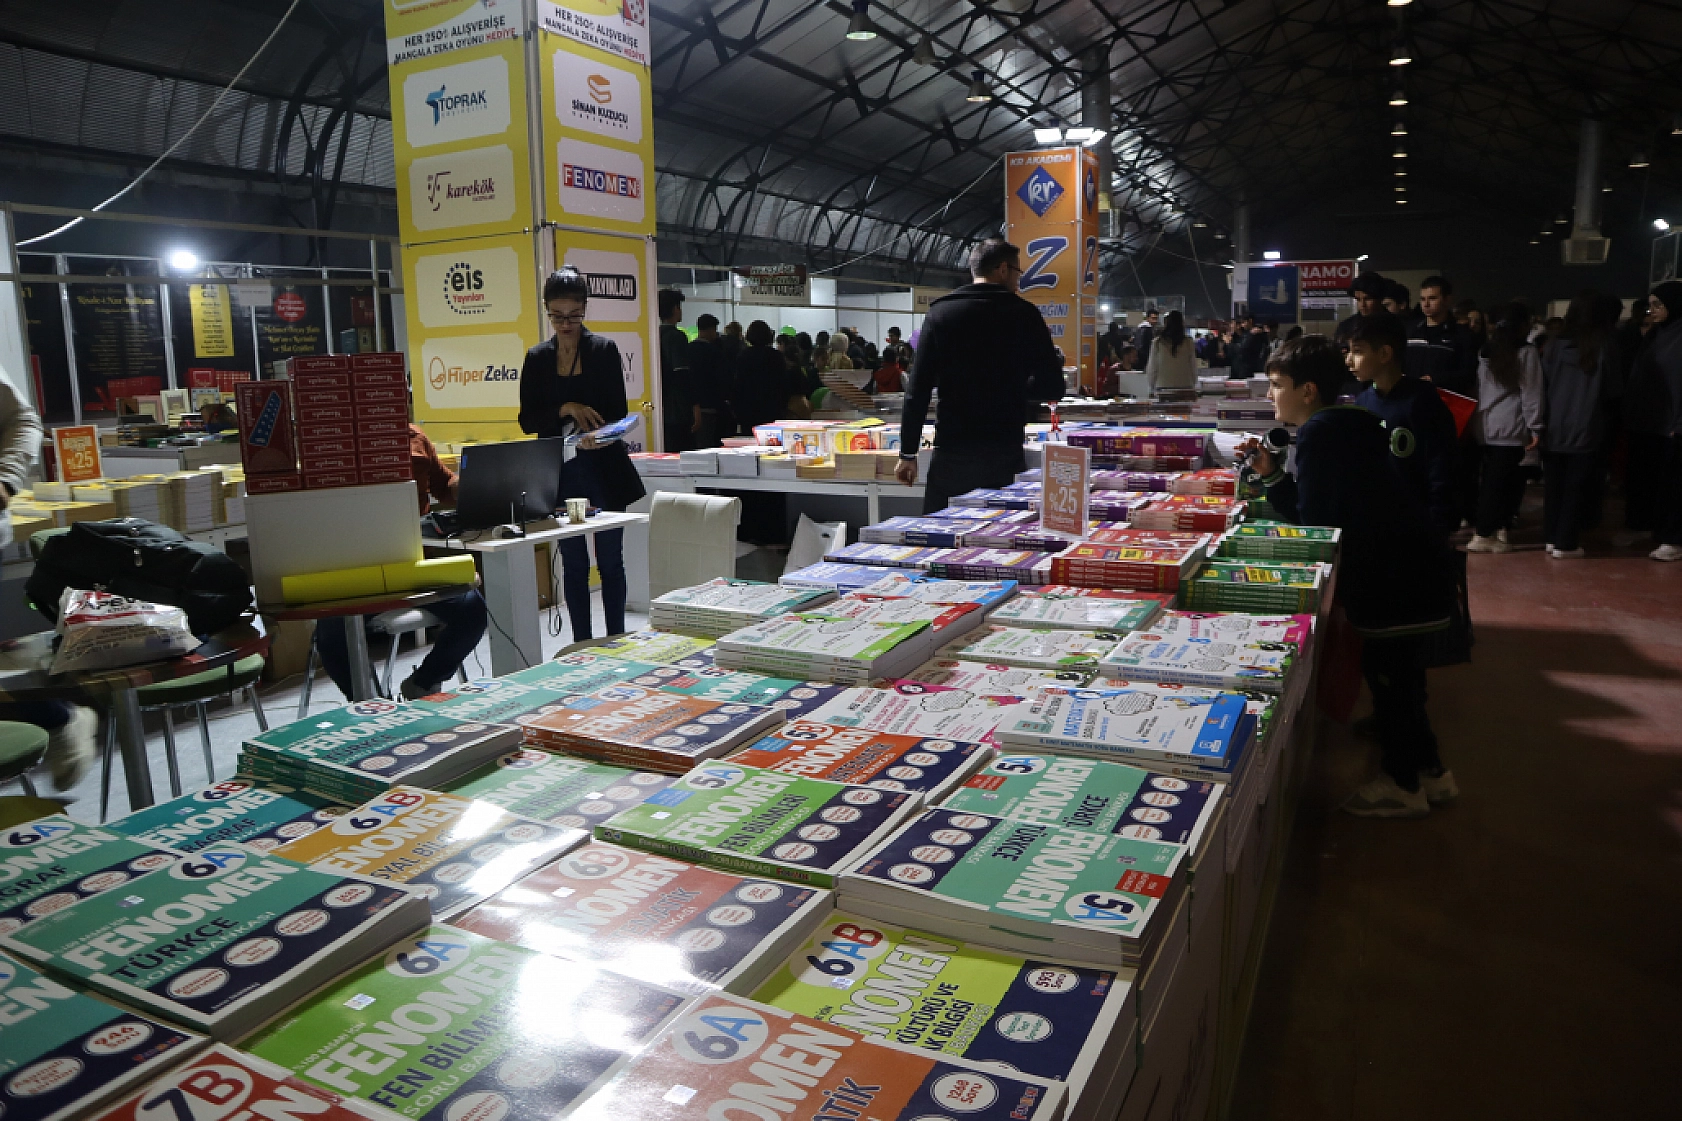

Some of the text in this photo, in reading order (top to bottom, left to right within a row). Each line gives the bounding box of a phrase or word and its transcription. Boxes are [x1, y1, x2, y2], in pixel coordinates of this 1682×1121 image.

[405, 14, 505, 48] HER ALIŞVERİŞE
[556, 8, 572, 20] HER
[438, 90, 487, 111] TOPRAK
[572, 98, 628, 124] SİNAN KUZUCU
[446, 177, 494, 199] karekök
[563, 164, 638, 198] FENOMEN
[451, 270, 484, 292] eis
[589, 277, 634, 296] YAYINLARI
[1300, 265, 1350, 278] NAMO
[1038, 300, 1069, 317] AĞINI
[448, 364, 518, 386] HiperZeka
[1049, 486, 1078, 515] %25
[437, 683, 538, 720] ENOMEN
[285, 706, 437, 759] FENOMEN
[685, 764, 746, 788] 5A
[996, 756, 1039, 774] 5A
[203, 782, 250, 800] 6B
[658, 769, 802, 846] FENOMEN
[130, 789, 281, 850] ENOME
[350, 792, 422, 829] 6AB
[9, 825, 71, 845] 6A
[179, 818, 256, 853] RAGRAF
[308, 796, 467, 873] ENOMEN
[712, 832, 758, 852] FEN
[0, 830, 120, 882] OMEN
[169, 846, 250, 880] 6A
[370, 854, 421, 880] SYAL
[569, 850, 624, 876] 6B
[996, 828, 1107, 918] FENOMEN
[0, 864, 68, 896] GRAF
[550, 857, 690, 934] NOMEN
[57, 856, 302, 974] FENOMEN
[652, 906, 699, 938] ANKASI
[1074, 894, 1136, 921] 5A
[101, 912, 243, 984] TÜRKÇE
[131, 954, 196, 989] SORU
[193, 910, 277, 955] BANKASI
[382, 933, 470, 977] 6A
[805, 922, 884, 978] 6AB
[829, 933, 962, 1038] NOMEN
[933, 982, 960, 996] VE
[1036, 971, 1056, 988] 593
[300, 943, 538, 1098] FENOMEN
[932, 998, 974, 1038] BİLGİSİ
[683, 1015, 763, 1060] 6A
[366, 1065, 436, 1111] FEN
[705, 1022, 854, 1121] OMEN
[141, 1070, 246, 1121] 7B
[400, 1072, 463, 1118] SORU
[960, 1082, 983, 1105] Soru
